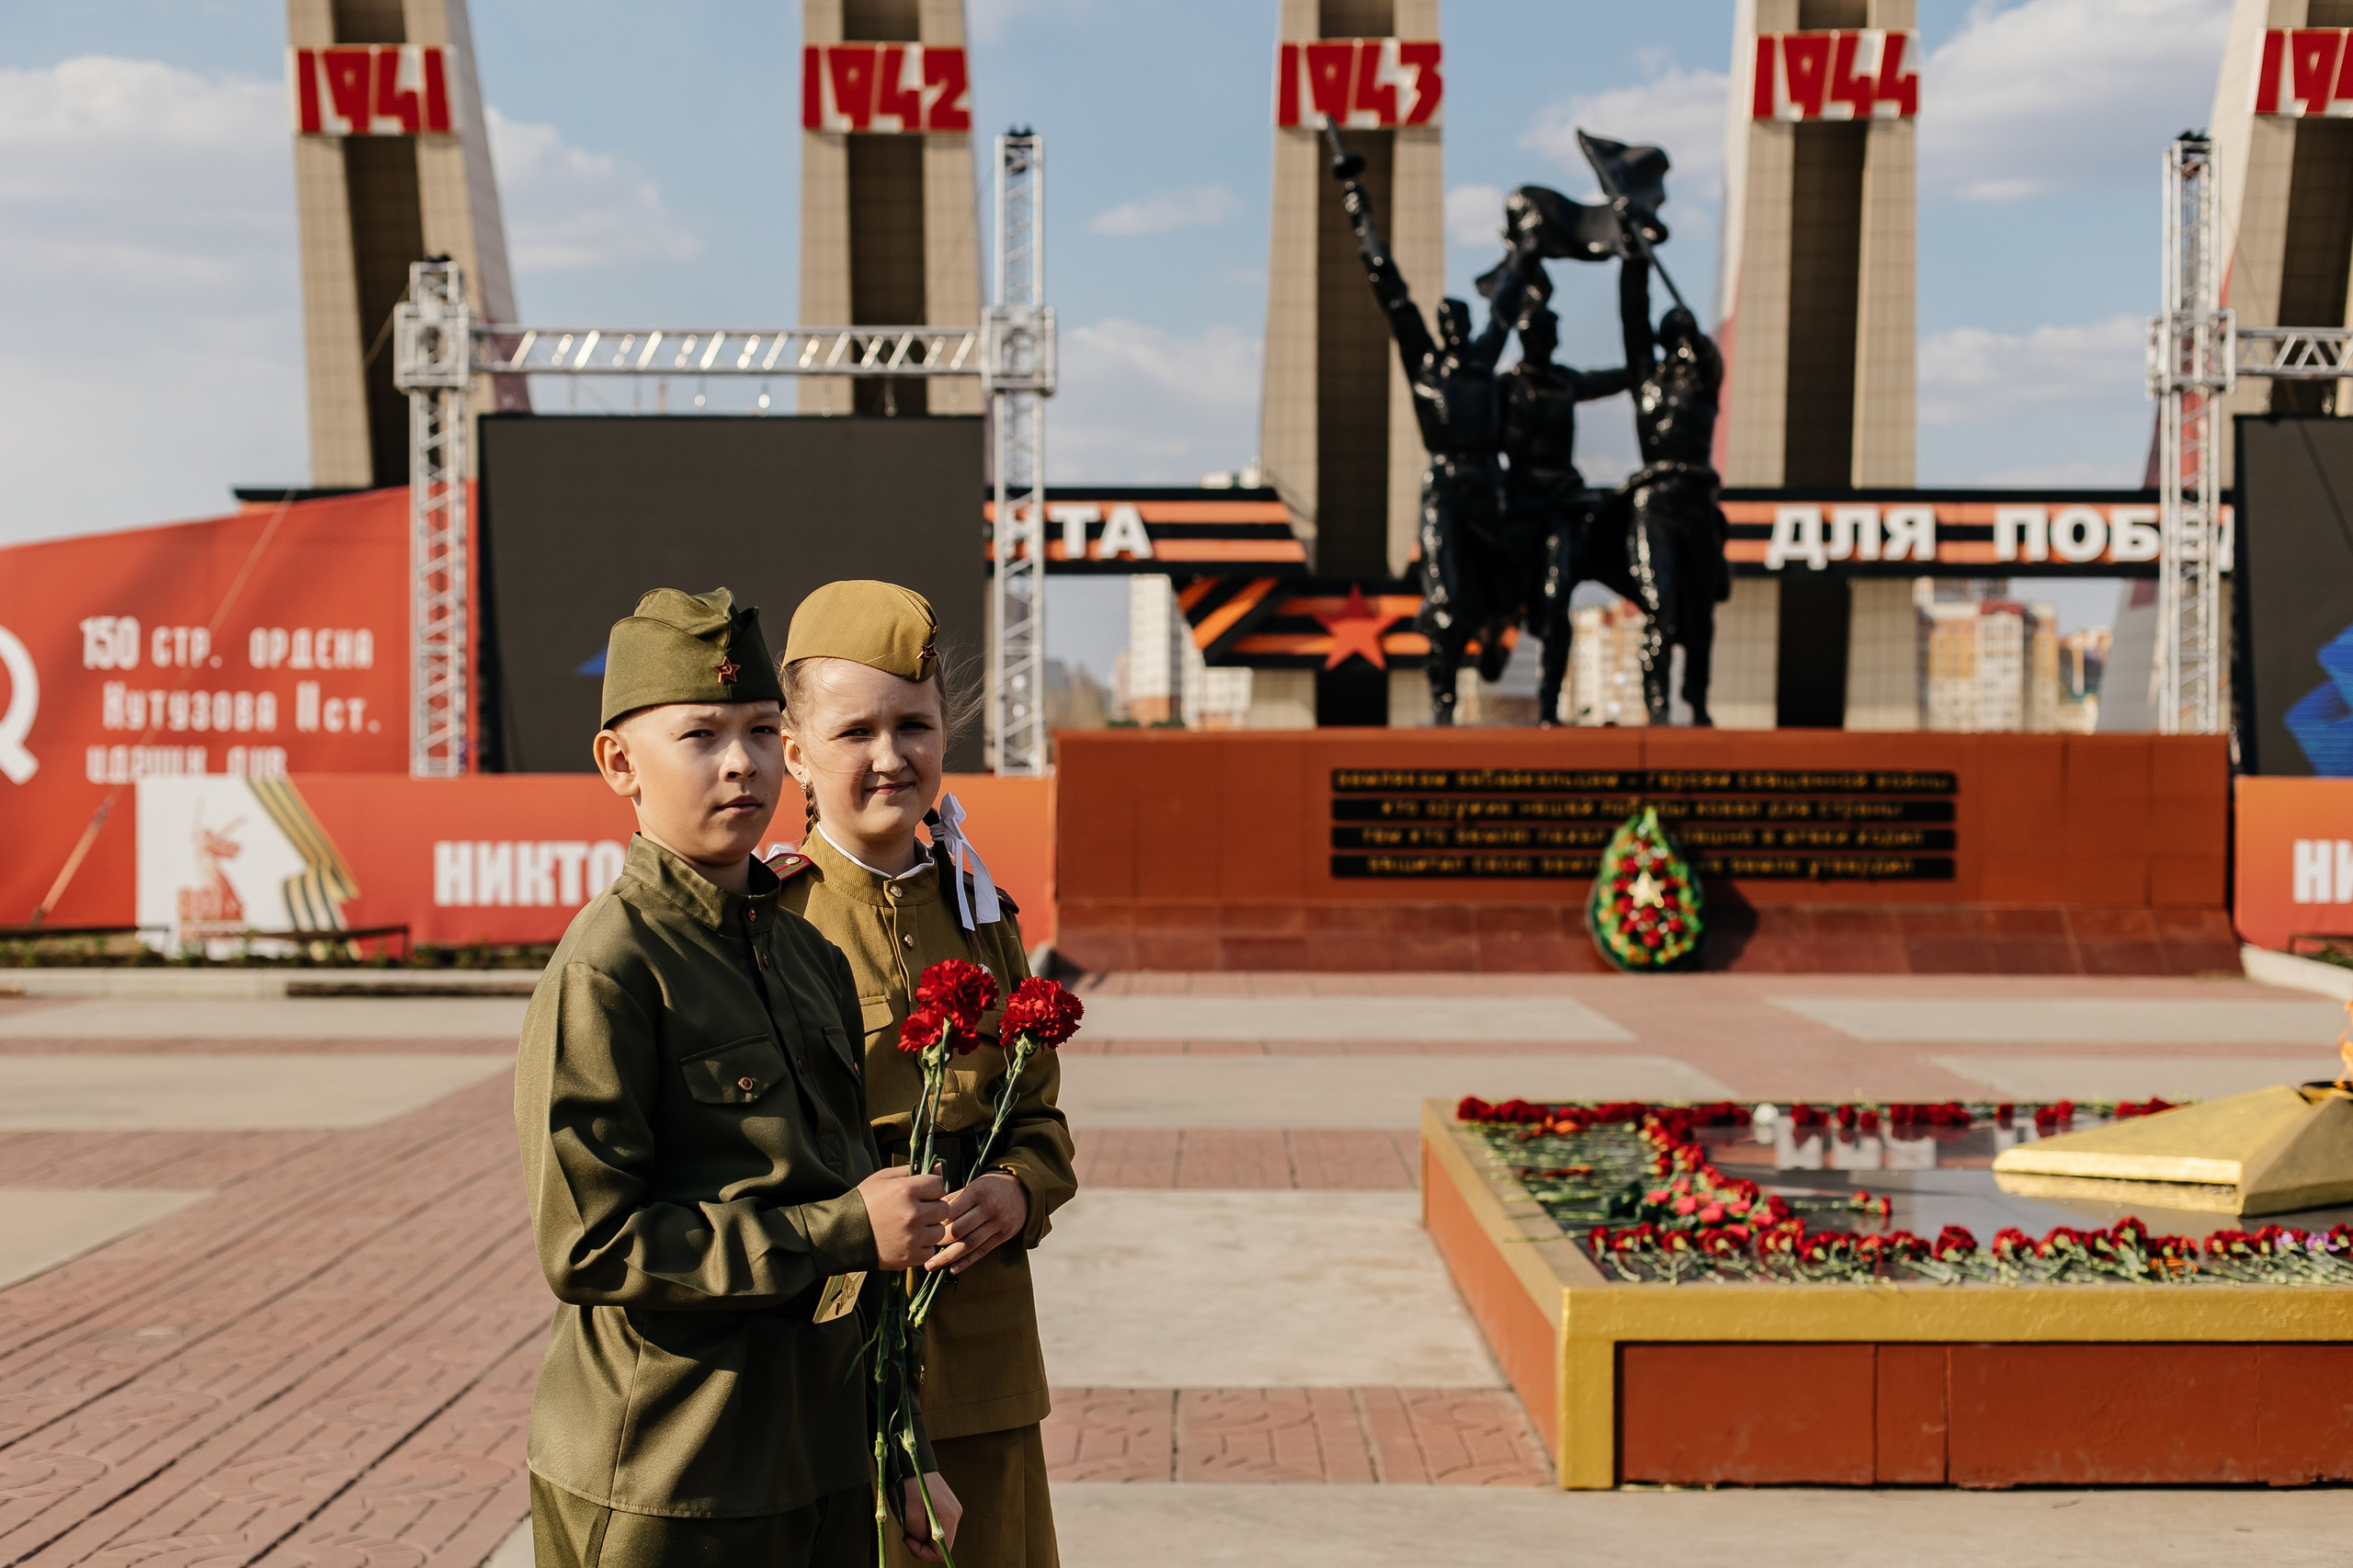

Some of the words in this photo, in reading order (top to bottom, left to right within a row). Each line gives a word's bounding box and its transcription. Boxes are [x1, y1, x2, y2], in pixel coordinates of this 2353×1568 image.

[296, 46, 453, 133] 1941
[802, 44, 972, 131] 1942
[1278, 40, 1444, 127] 1943
[1752, 30, 1920, 119] 1944
[1764, 504, 1936, 571] ДЛЯ
[80, 616, 141, 670] 150
[434, 840, 627, 907] НИКТО
